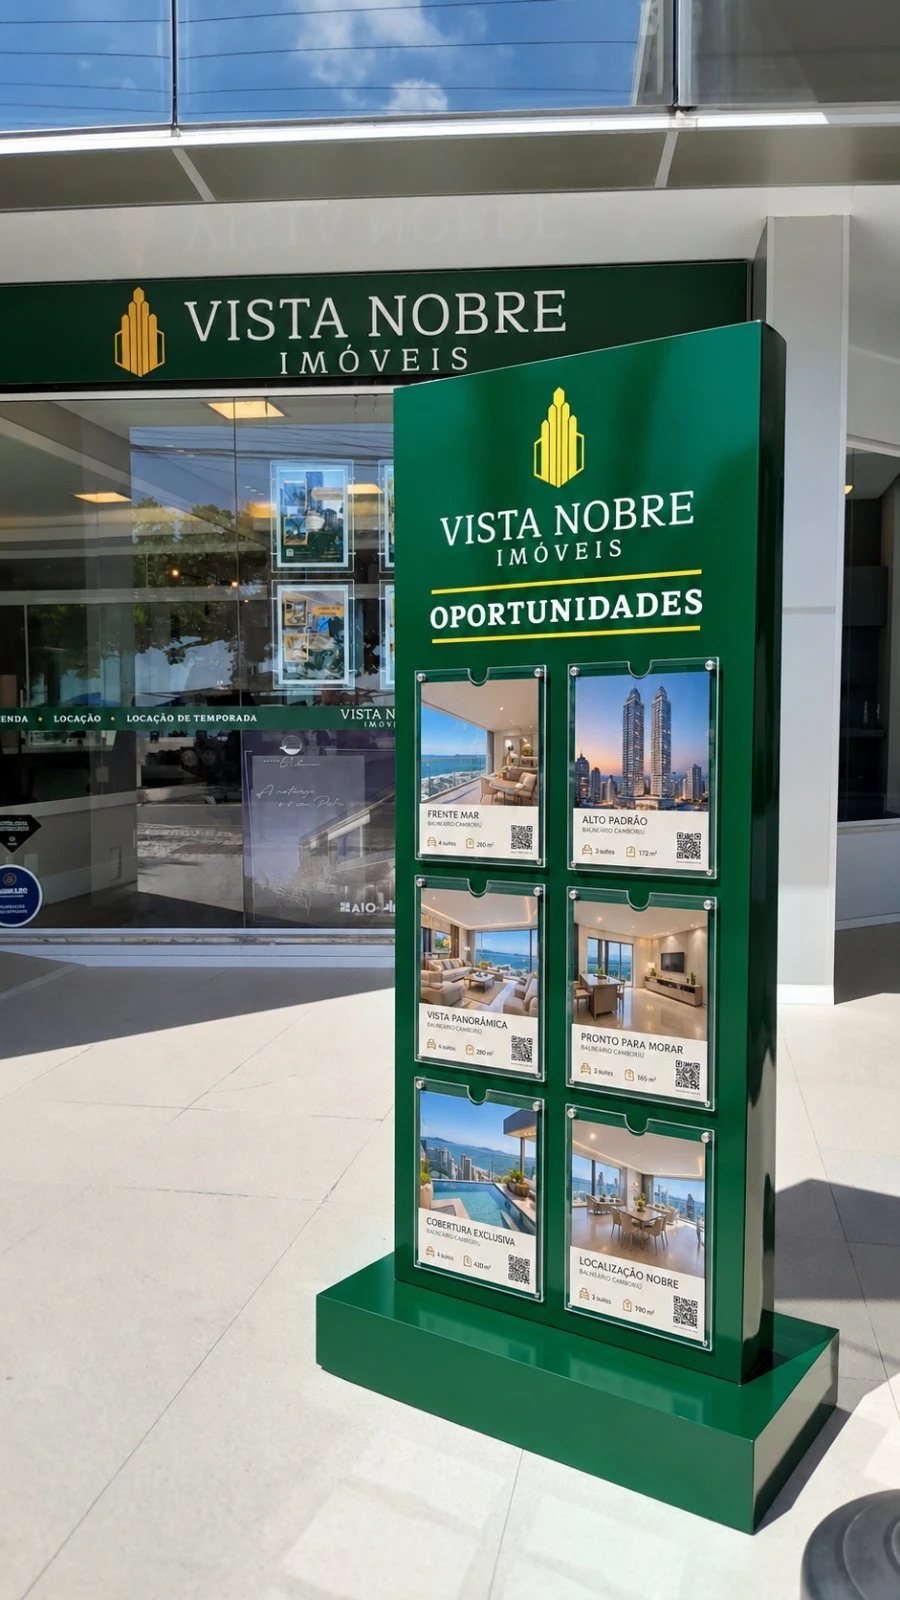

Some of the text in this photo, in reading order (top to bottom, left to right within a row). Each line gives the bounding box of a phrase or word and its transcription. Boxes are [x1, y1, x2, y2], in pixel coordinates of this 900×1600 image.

[185, 290, 567, 342] VISTA NOBRE
[280, 344, 469, 374] IMÓVEIS
[440, 490, 694, 546] VISTA NOBRE
[497, 539, 622, 566] IMÓVEIS
[430, 589, 703, 629] OPORTUNIDADES
[54, 714, 101, 725] LOCAÇÃO
[127, 713, 174, 725] LOCAÇÃO
[178, 714, 190, 722] DE
[194, 714, 257, 722] TEMPORADA
[341, 708, 382, 720] VISTA
[427, 810, 479, 819] FRENTE MAR
[582, 815, 648, 826] ALTO PADRÃO
[427, 1011, 508, 1029] VISTA PANORÂMICA
[581, 1032, 684, 1054] PRONTO PARA MORAR
[426, 1217, 516, 1246] COBERTURA EXCLUSIVA
[579, 1257, 679, 1290] LOCALIZAÇÃO NOBRE
